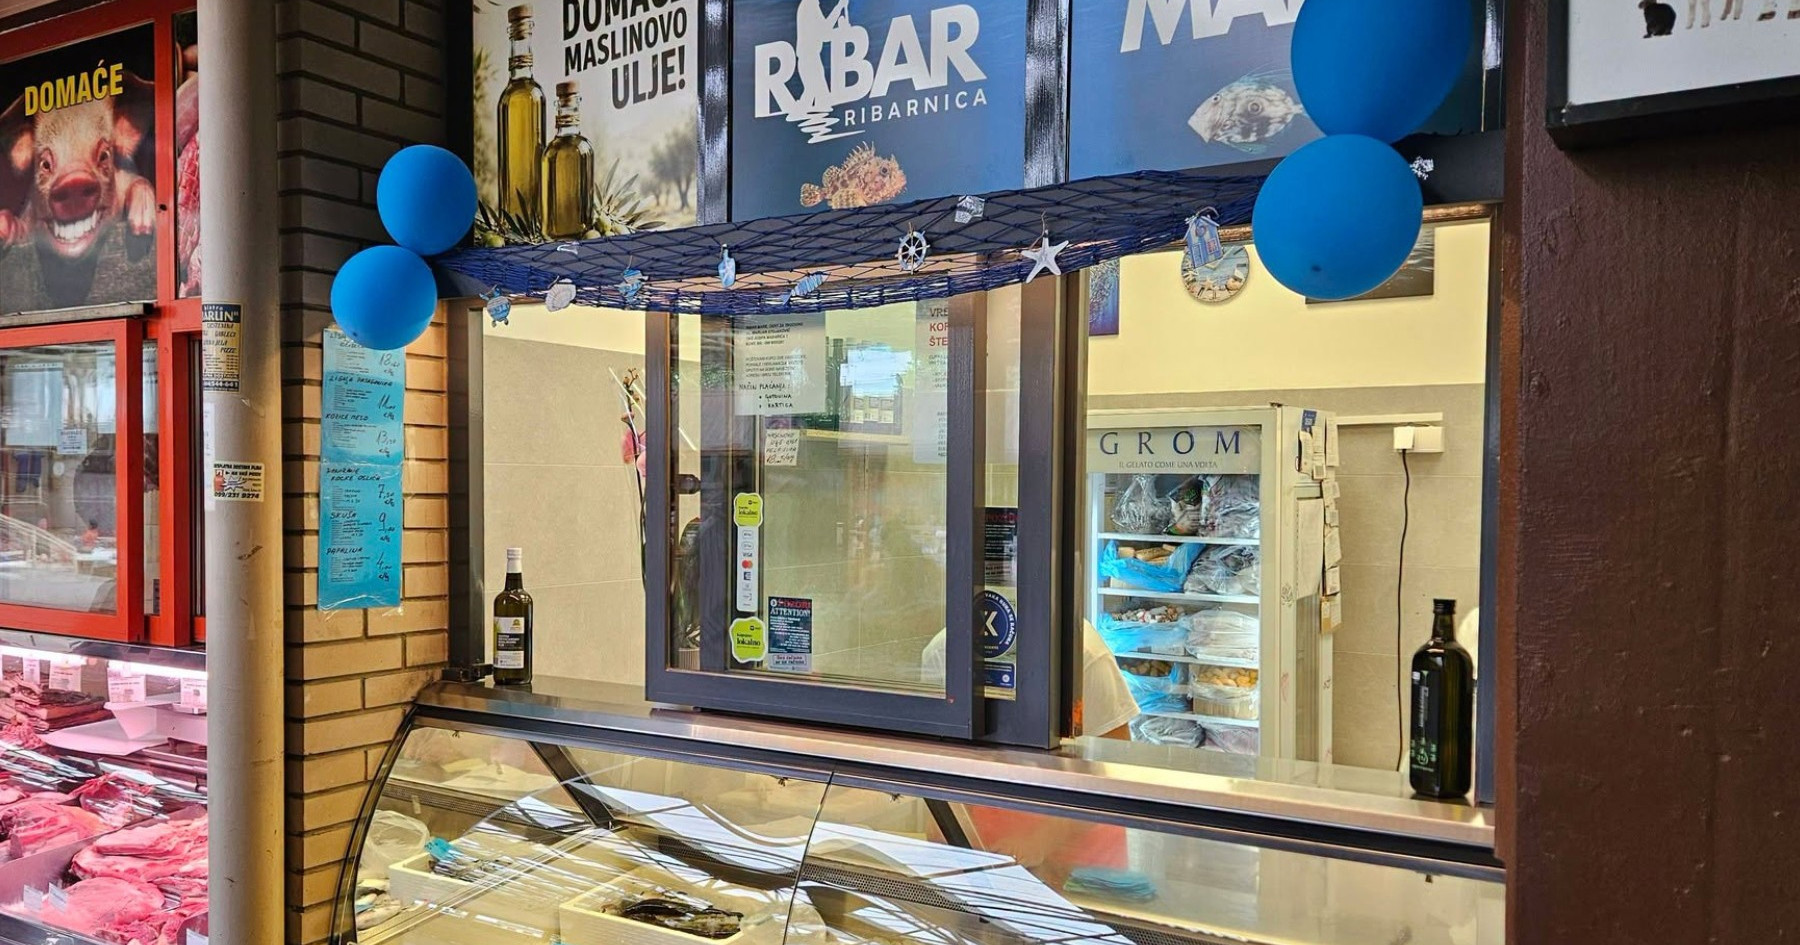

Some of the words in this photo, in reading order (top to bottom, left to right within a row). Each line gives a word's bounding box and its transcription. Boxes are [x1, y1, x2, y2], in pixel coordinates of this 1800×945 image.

[565, 7, 687, 77] MASLINOVO
[24, 59, 123, 116] DOMAĆE
[612, 45, 686, 109] ULJE!
[844, 88, 987, 126] RIBARNICA
[929, 308, 948, 317] VRE
[929, 336, 948, 346] ŠTE
[1100, 430, 1241, 455] GROM
[1155, 461, 1175, 469] COME
[737, 638, 761, 646] lokalno
